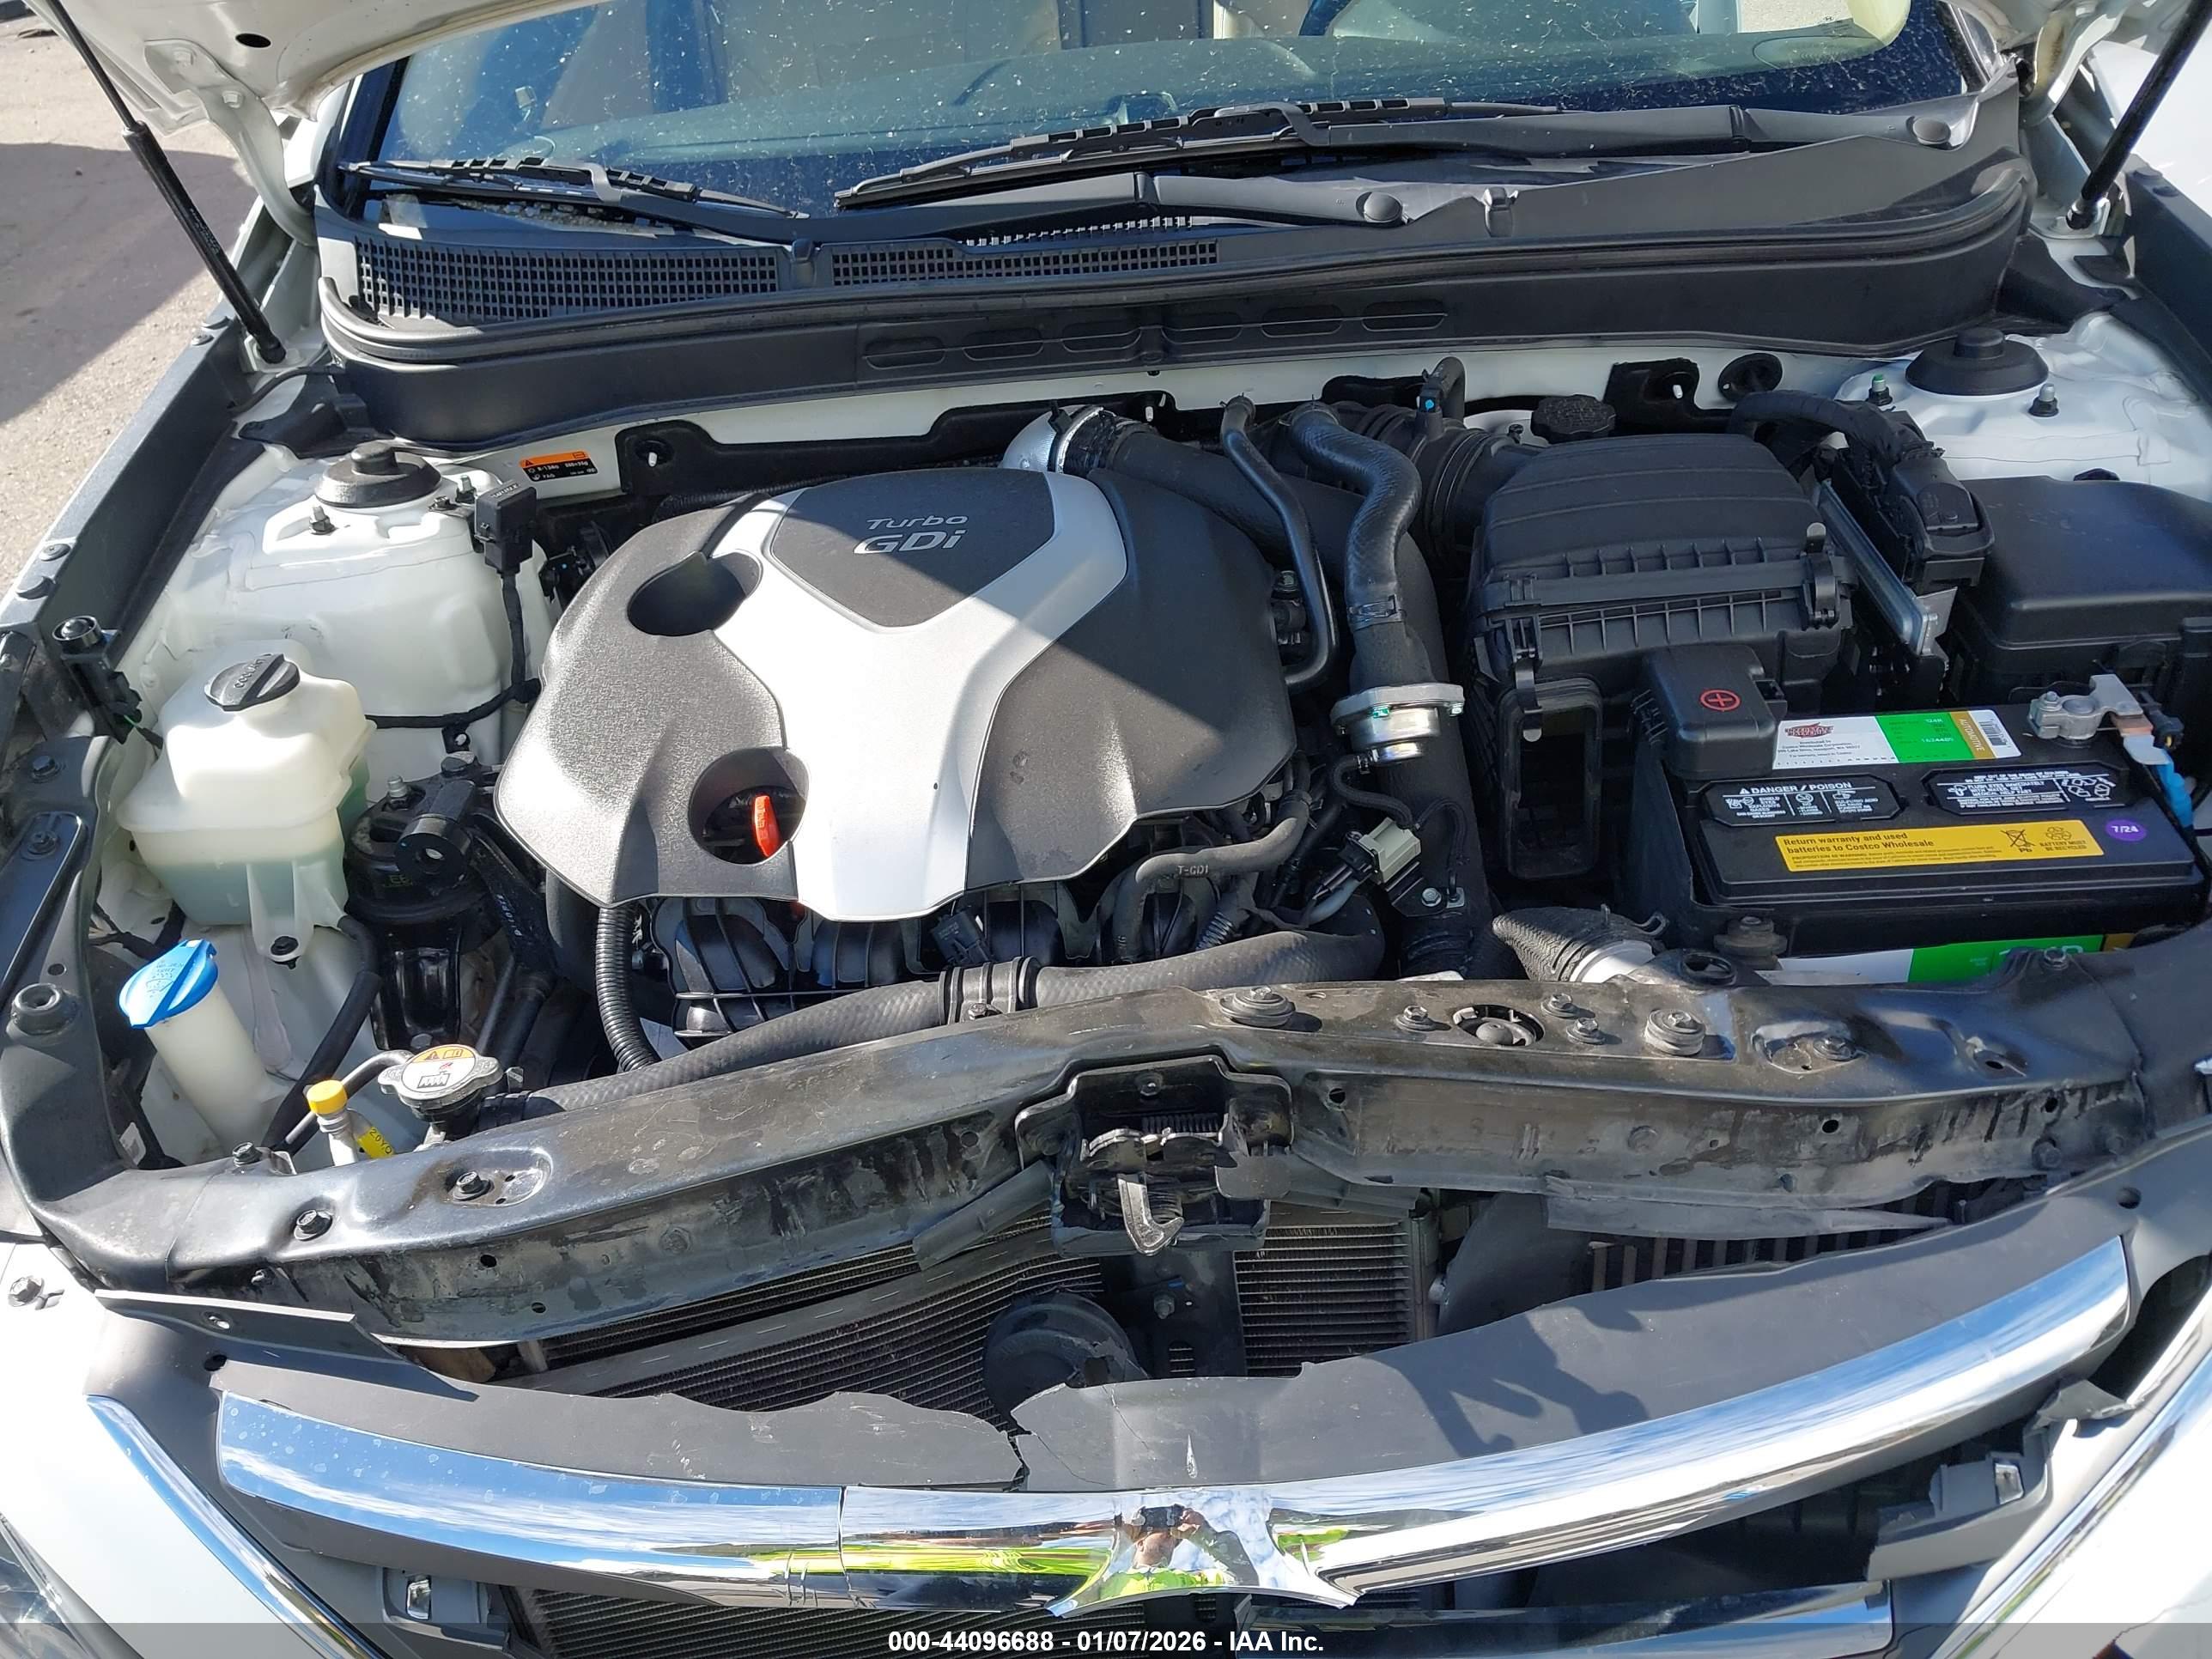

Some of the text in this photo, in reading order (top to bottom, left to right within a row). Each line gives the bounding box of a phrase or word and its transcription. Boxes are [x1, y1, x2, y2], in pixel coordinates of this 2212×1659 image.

[866, 515, 969, 530] Turbo
[854, 529, 968, 555] GDi
[1959, 718, 1985, 752] AUTOMOTIVE
[1750, 785, 1799, 794] DANGER
[1808, 781, 1852, 791] POISON
[1787, 845, 1832, 854] batteries
[1845, 842, 1881, 850] Costco
[1881, 839, 1935, 848] Wholesale
[1819, 836, 1861, 844] warranty
